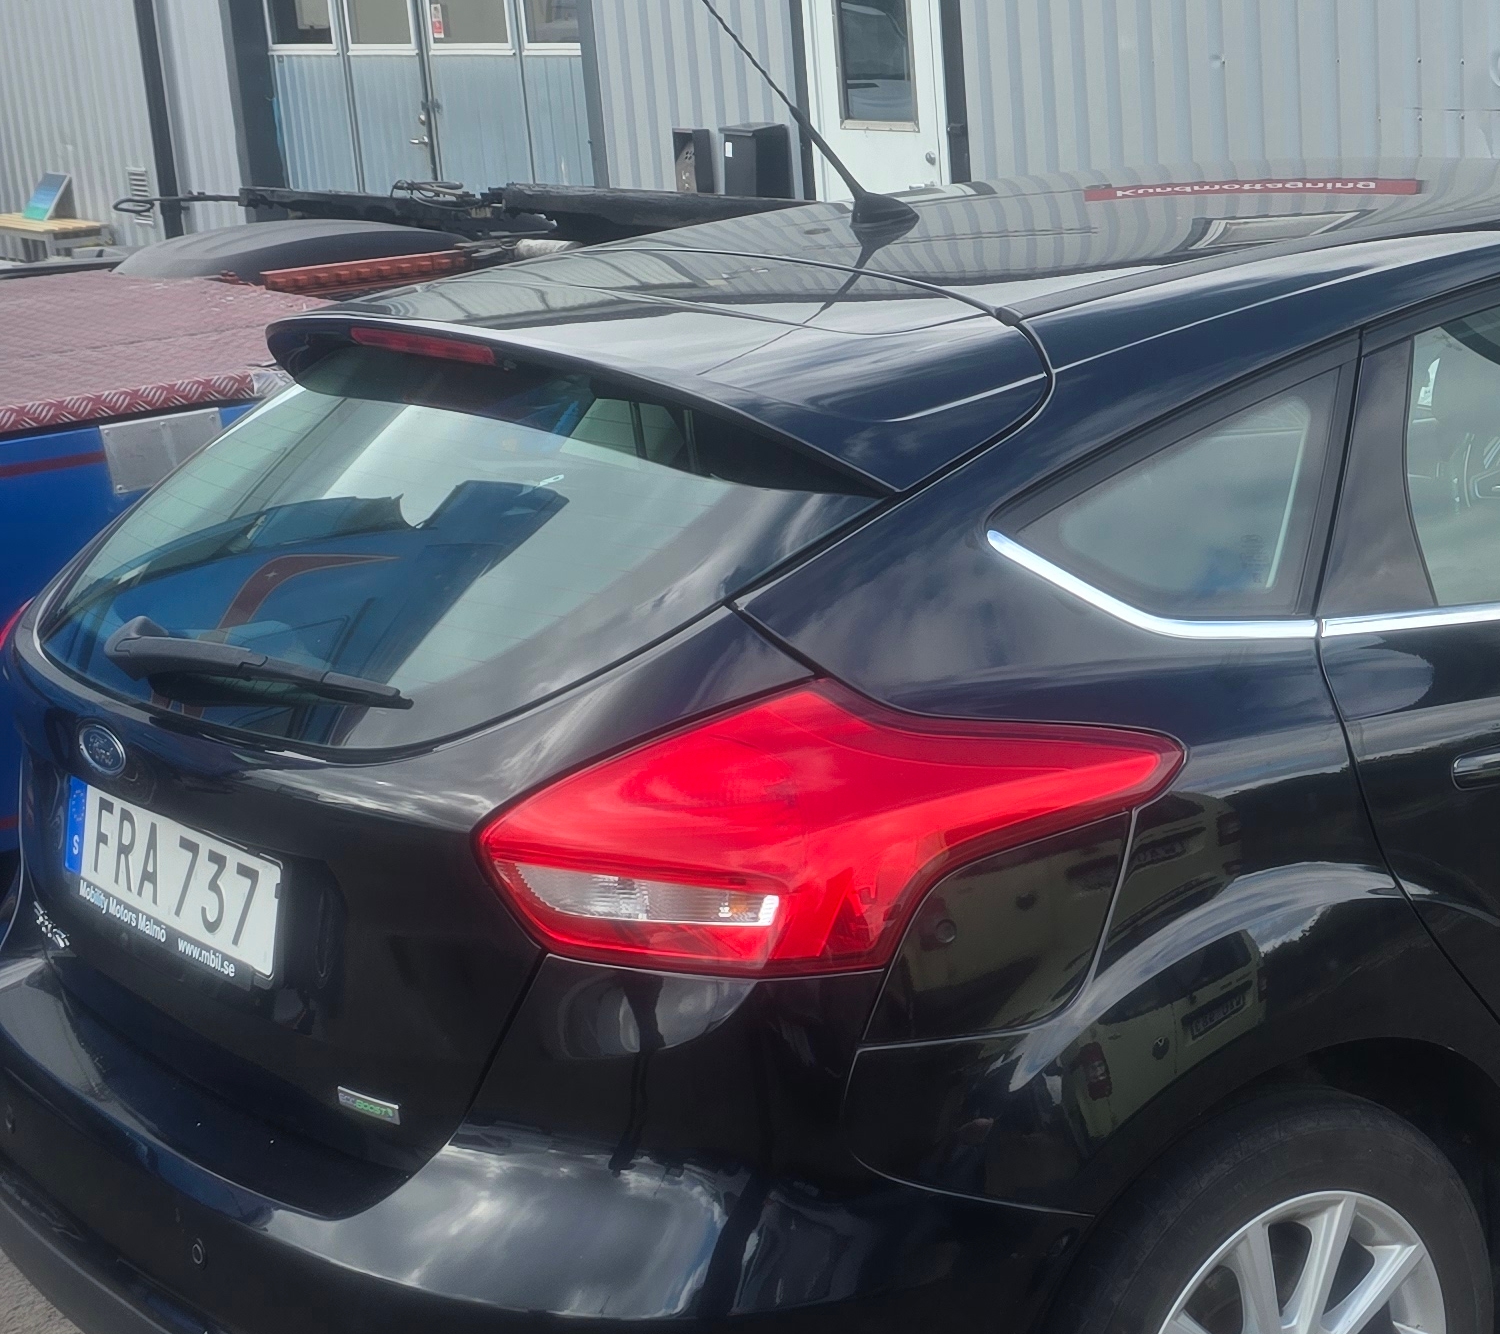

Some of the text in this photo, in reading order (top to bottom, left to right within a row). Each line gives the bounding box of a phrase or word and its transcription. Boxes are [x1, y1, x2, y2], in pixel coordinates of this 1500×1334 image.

[72, 834, 80, 855] S
[93, 796, 158, 906] FRA
[174, 835, 260, 947] 737
[79, 879, 109, 915] Mobility
[109, 896, 137, 927] Motors
[138, 915, 167, 943] Malmö
[177, 937, 236, 977] www.mbil.se
